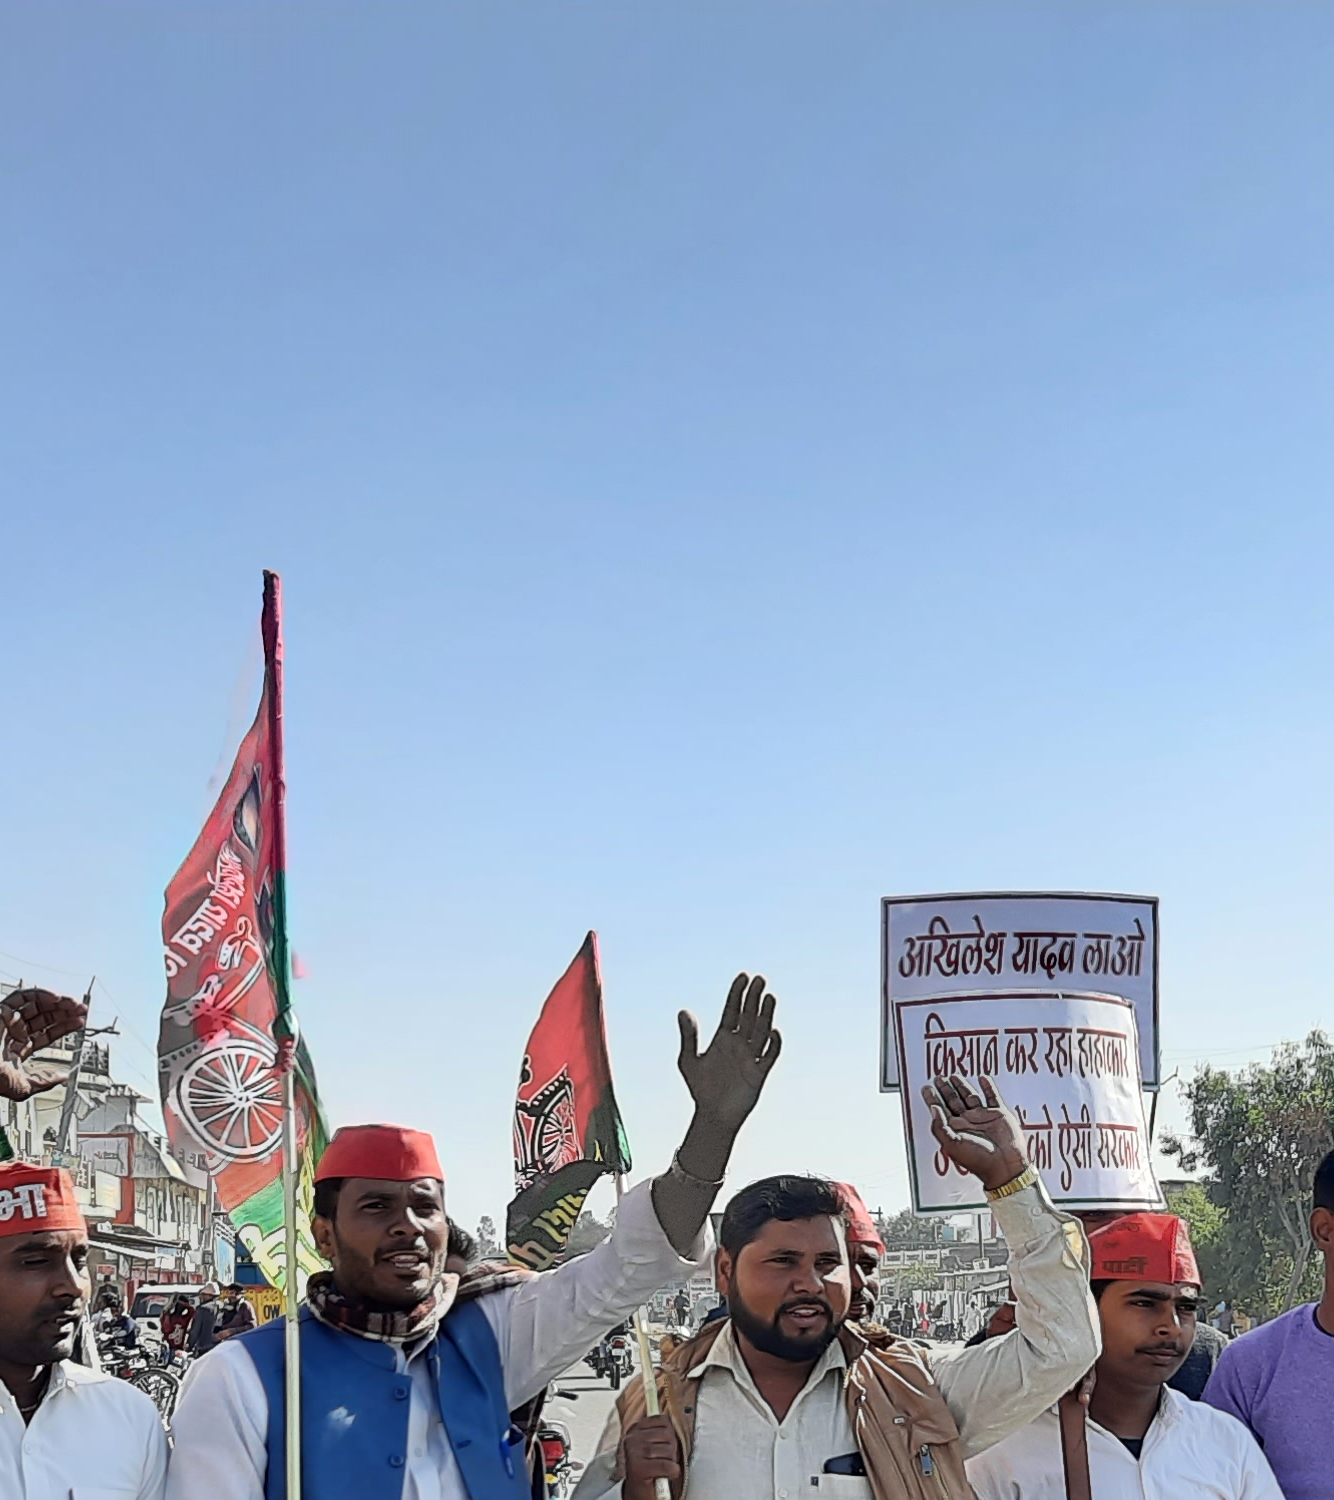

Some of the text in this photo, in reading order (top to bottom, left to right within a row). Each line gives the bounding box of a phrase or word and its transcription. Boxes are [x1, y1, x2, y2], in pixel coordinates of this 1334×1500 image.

[898, 915, 1145, 980] अखिलेश यादव लाओ
[924, 1012, 1129, 1079] किसान कर रहा हाहाकार
[1058, 1104, 1092, 1192] ऐसी
[1096, 1123, 1140, 1170] सरकार
